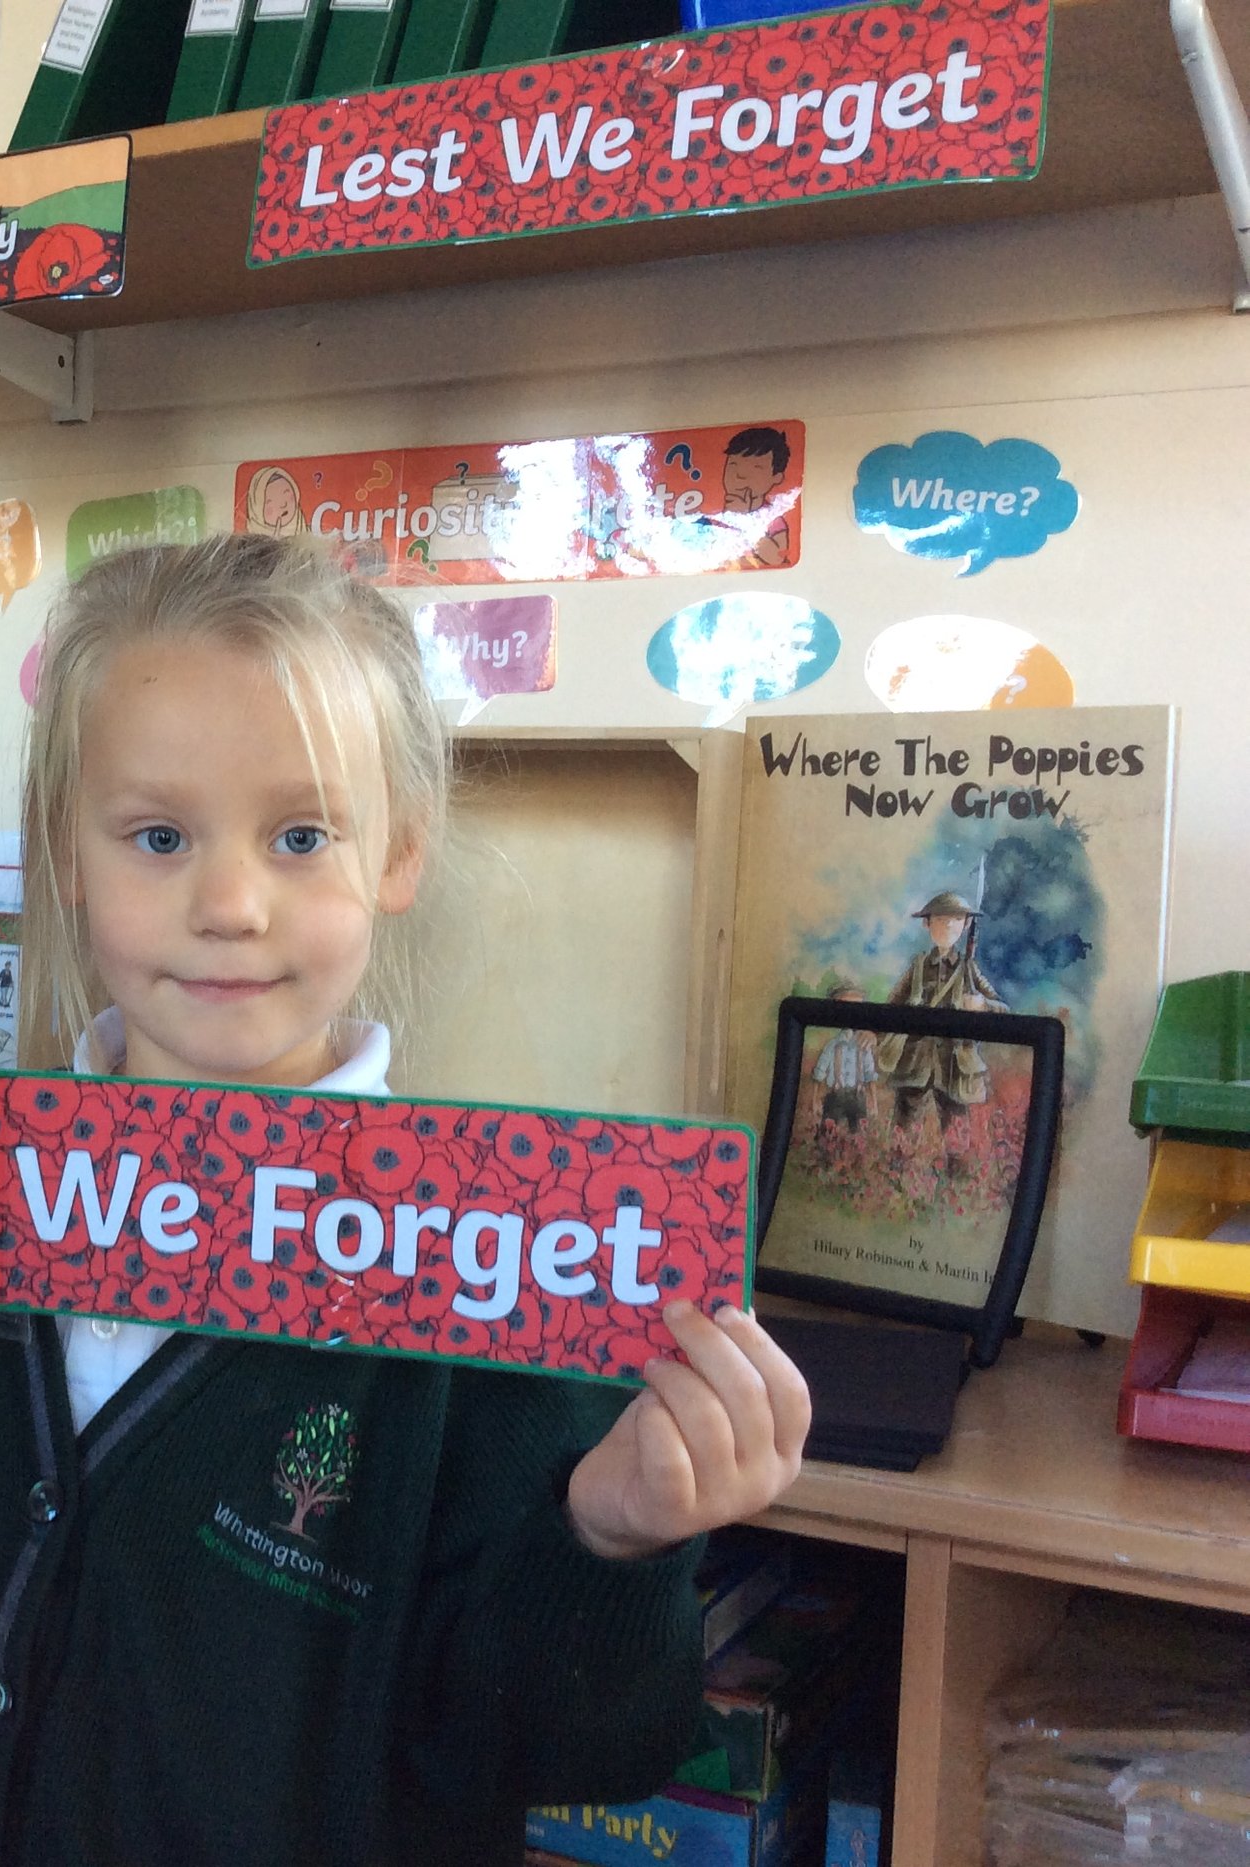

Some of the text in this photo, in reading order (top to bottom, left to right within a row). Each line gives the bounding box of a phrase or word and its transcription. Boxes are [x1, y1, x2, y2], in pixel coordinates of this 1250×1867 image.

[299, 49, 982, 209] Lest We Forget
[311, 489, 520, 543] Curiosit
[890, 476, 1040, 517] Where?
[759, 731, 1146, 788] Where The Poppies
[844, 781, 1072, 820] Now Grow
[14, 1145, 200, 1254] We
[250, 1165, 663, 1322] Forget
[908, 1235, 925, 1254] by
[813, 1239, 851, 1261] Hilary
[855, 1246, 915, 1270] Robinson
[918, 1259, 930, 1272] &
[935, 1261, 979, 1283] Martin
